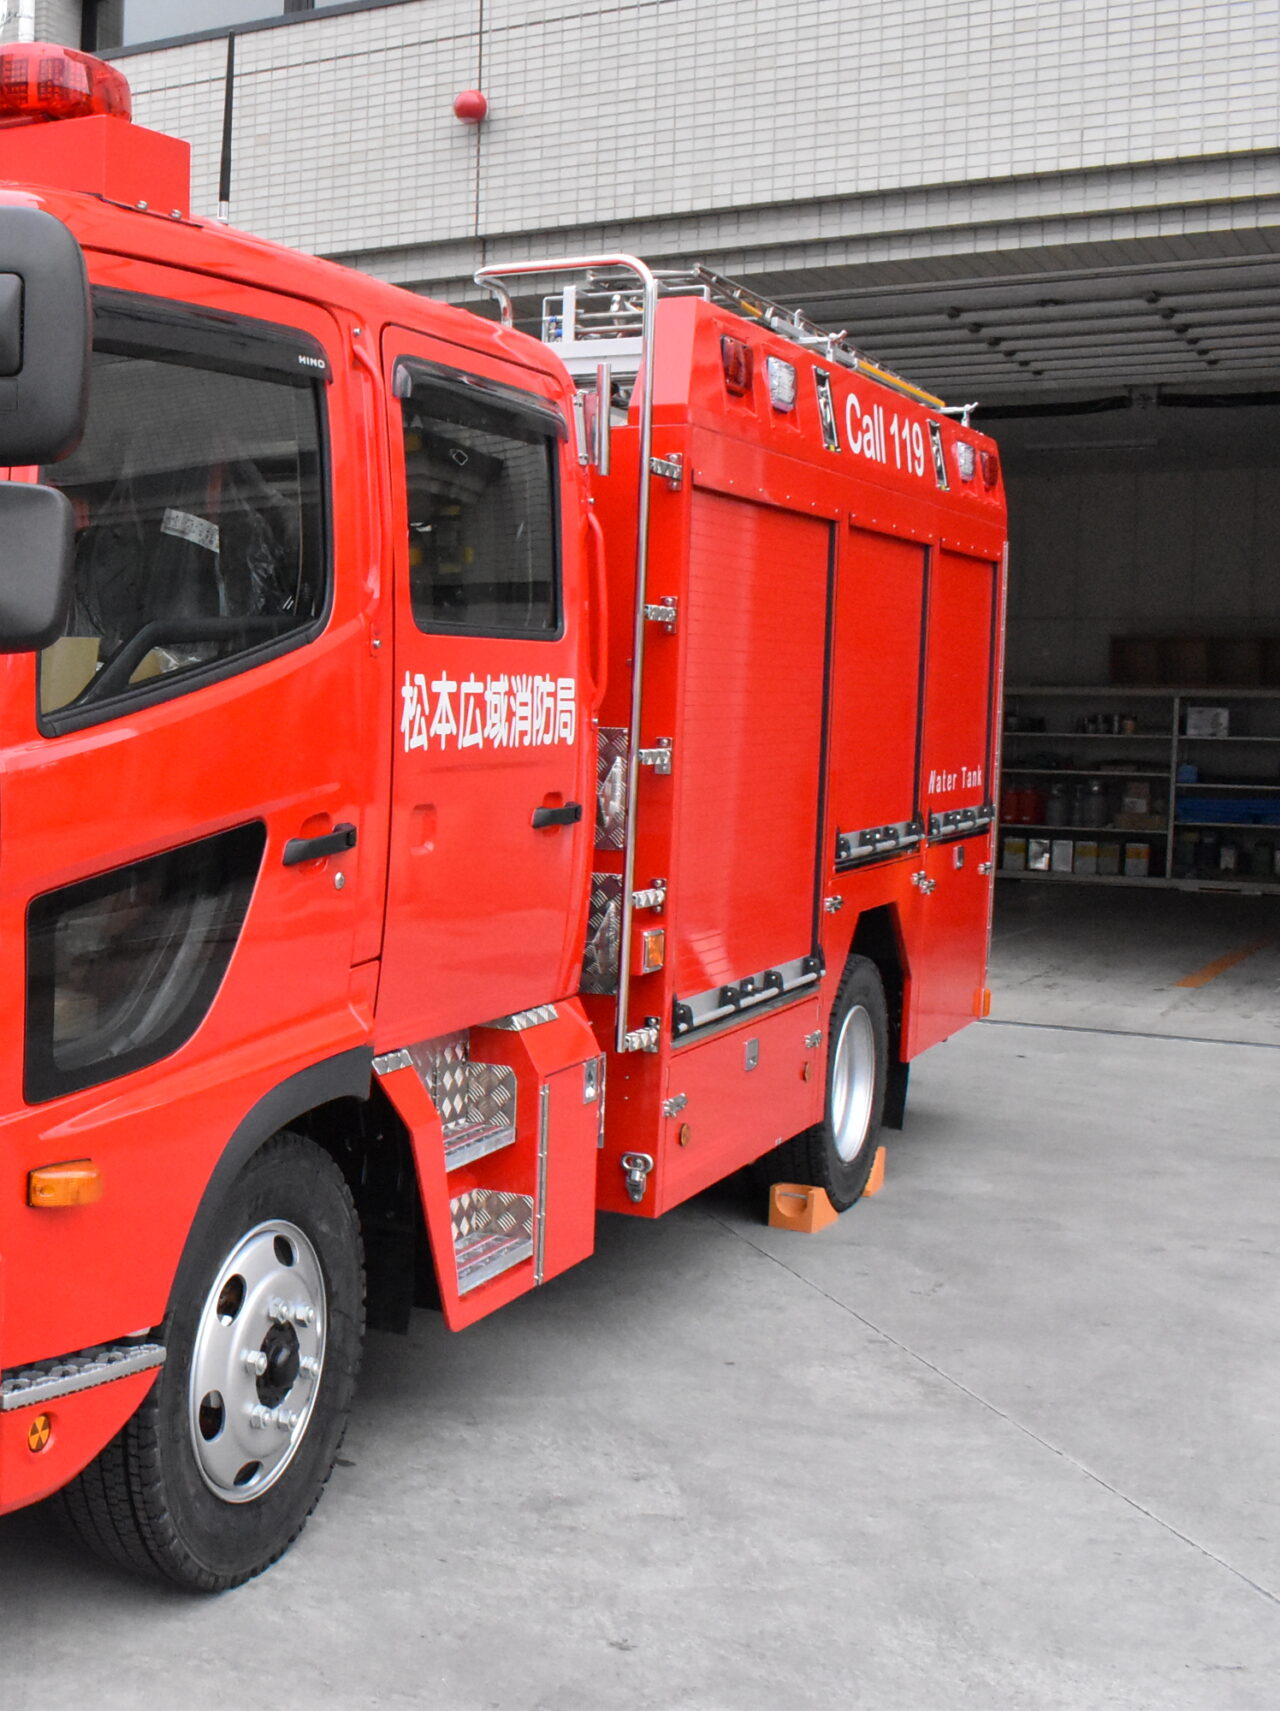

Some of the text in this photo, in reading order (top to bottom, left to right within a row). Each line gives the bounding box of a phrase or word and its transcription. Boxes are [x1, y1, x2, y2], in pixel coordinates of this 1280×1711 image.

[298, 355, 325, 369] HINO
[846, 393, 924, 477] Call 119
[401, 670, 575, 752] 松本広域消防局
[928, 765, 982, 794] Water Tank
